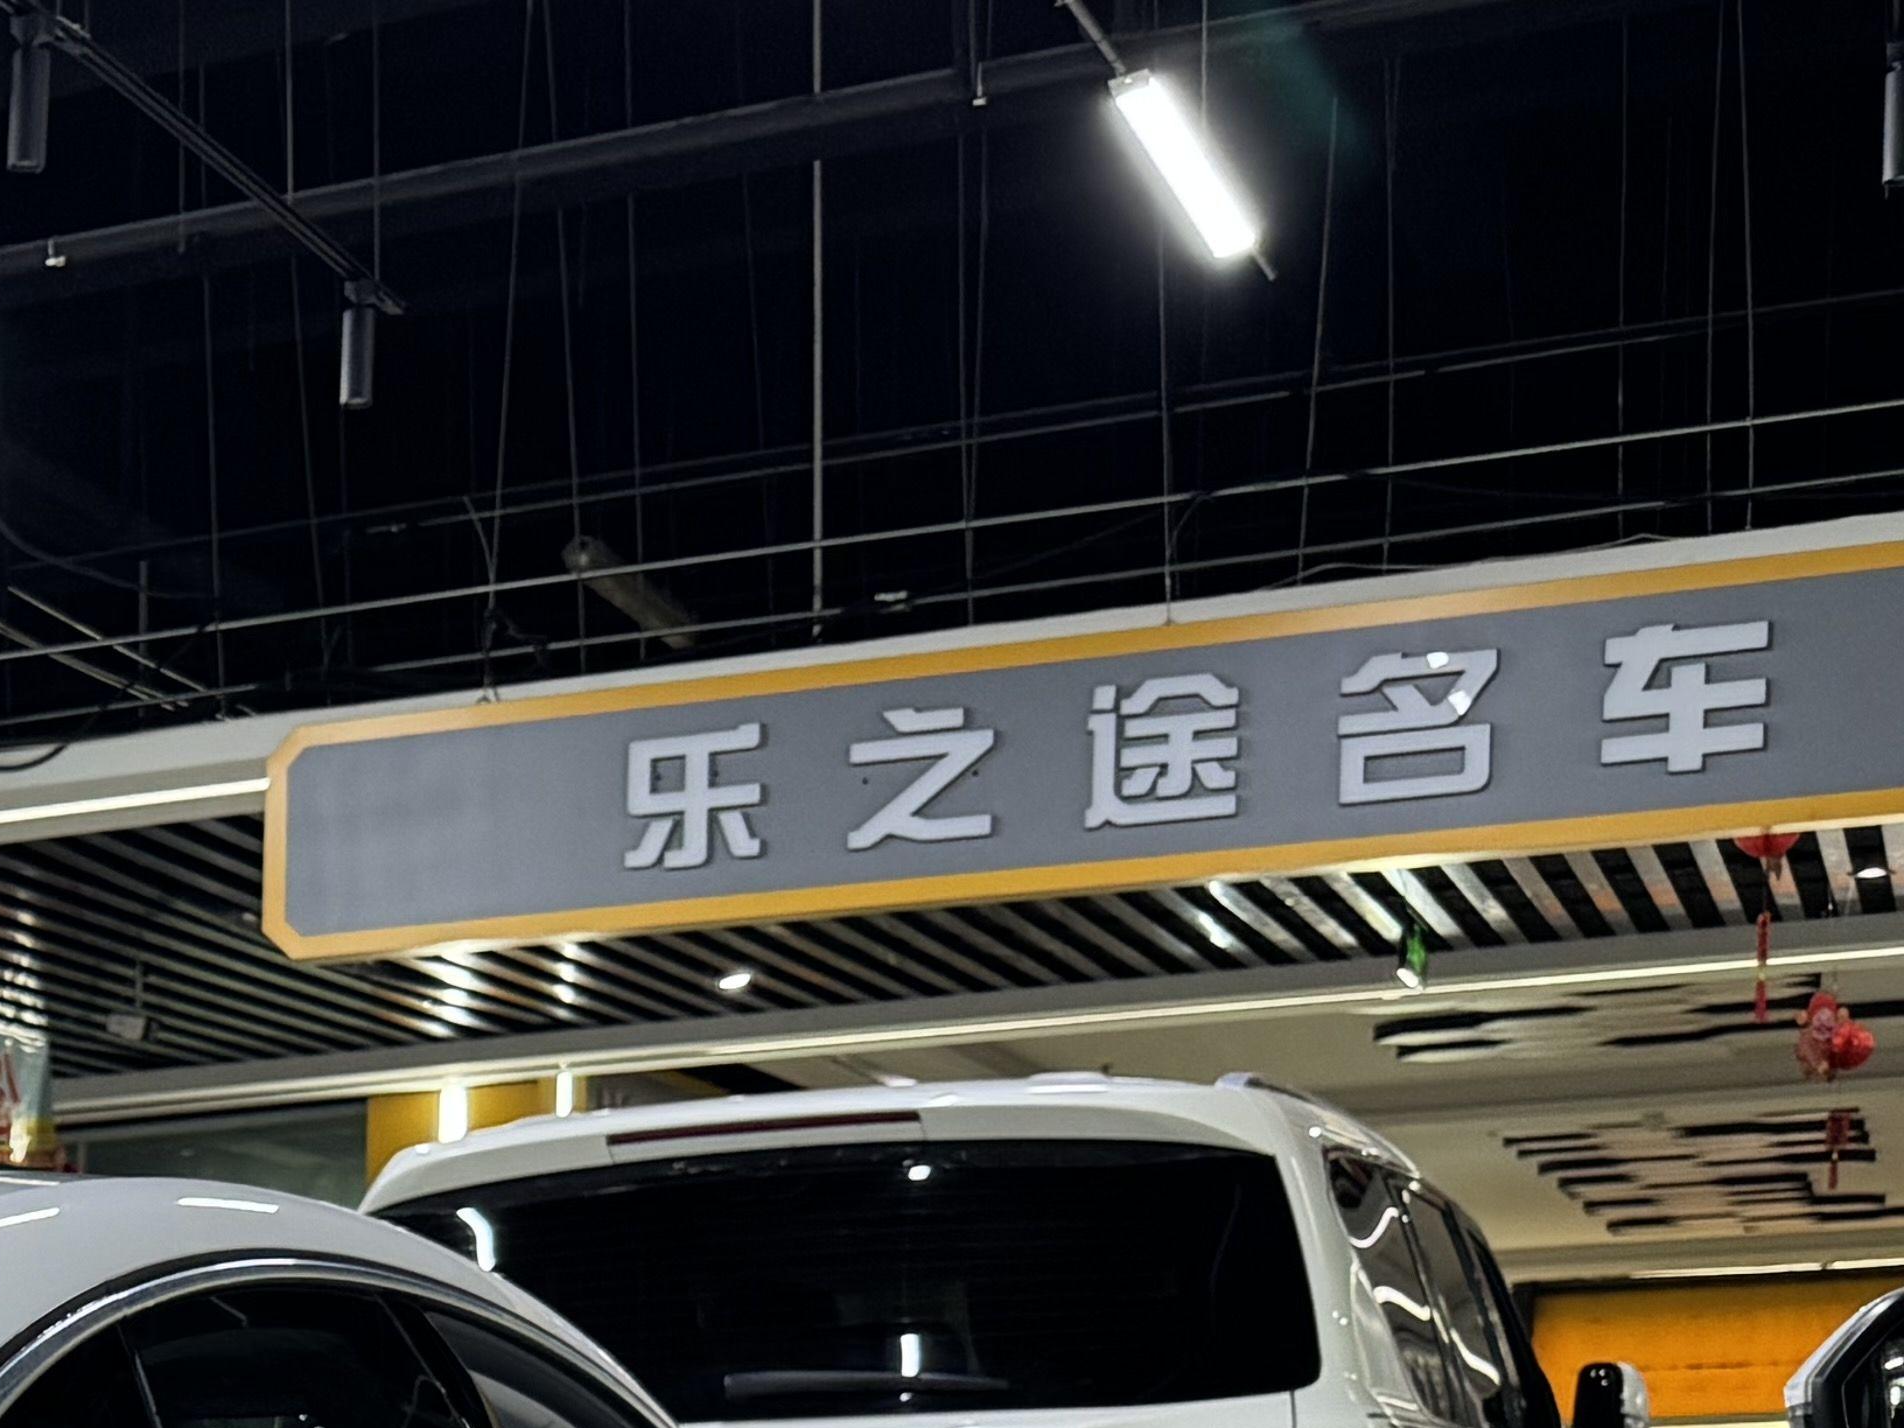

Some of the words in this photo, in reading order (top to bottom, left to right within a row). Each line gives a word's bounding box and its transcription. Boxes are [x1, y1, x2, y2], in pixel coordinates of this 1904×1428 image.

[622, 618, 1772, 872] 乐之途名车
